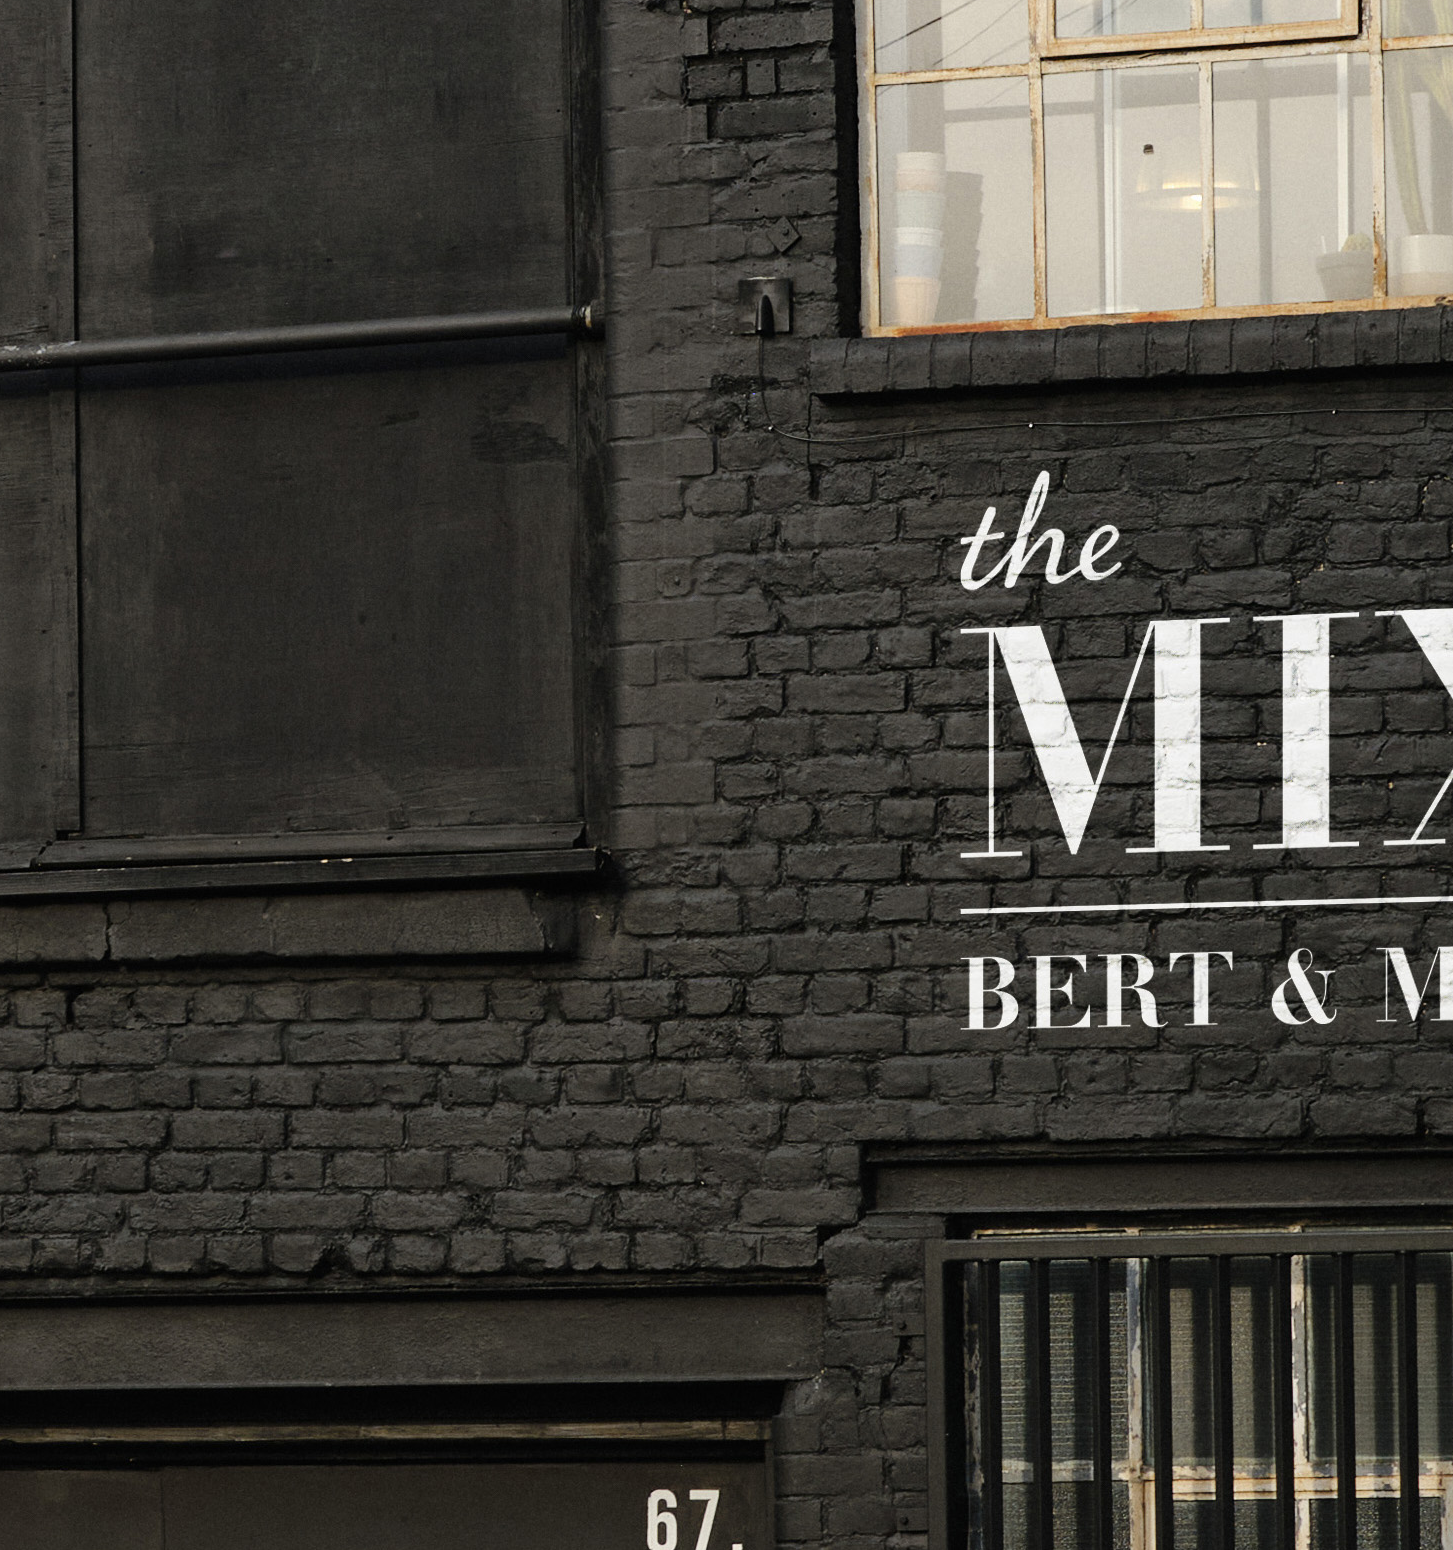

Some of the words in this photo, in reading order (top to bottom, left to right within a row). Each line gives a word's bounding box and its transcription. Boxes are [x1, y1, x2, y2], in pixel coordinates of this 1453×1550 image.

[961, 471, 1121, 590] the
[961, 952, 1232, 1030] BERT
[1272, 948, 1336, 1024] &
